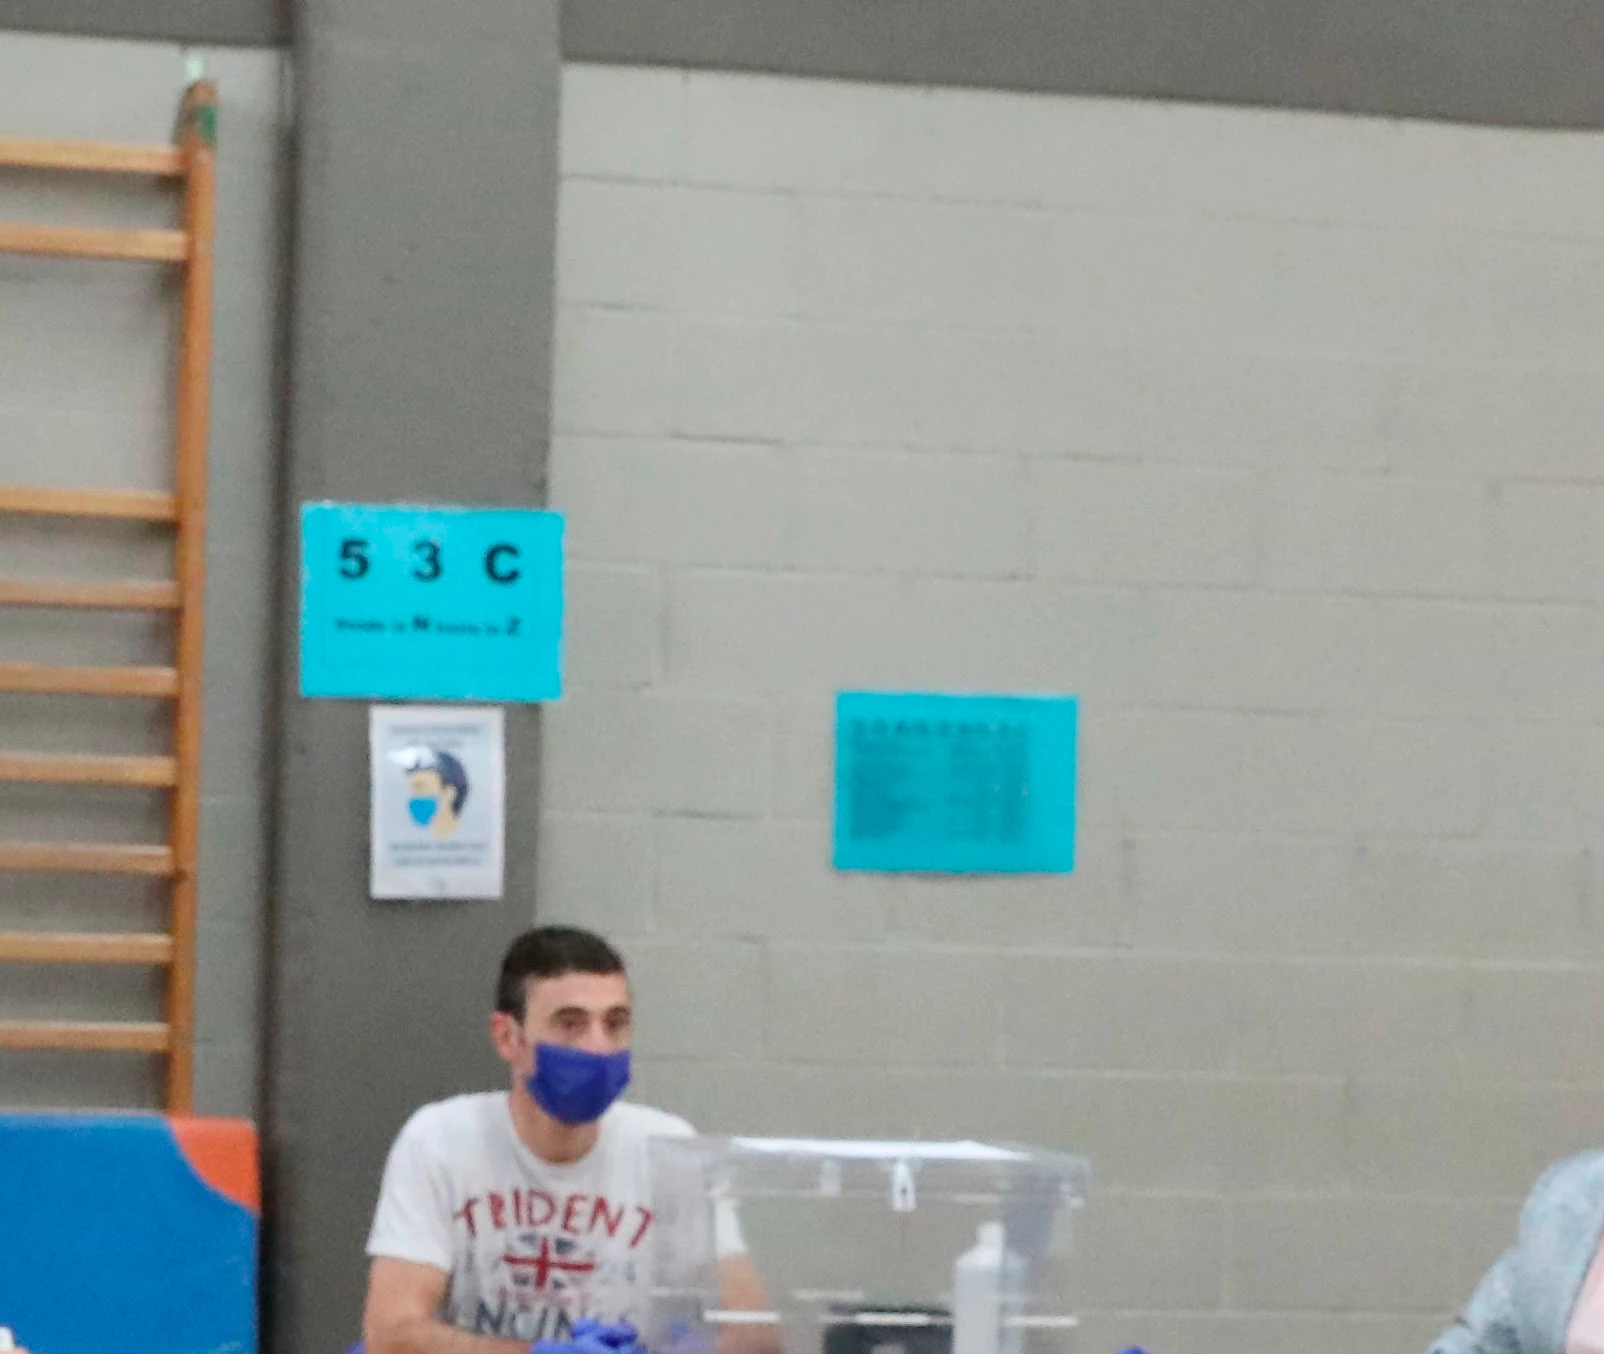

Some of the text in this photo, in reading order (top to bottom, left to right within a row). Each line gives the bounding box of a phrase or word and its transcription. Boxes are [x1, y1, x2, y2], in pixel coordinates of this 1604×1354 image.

[340, 540, 521, 584] 5 3 C
[453, 1188, 654, 1248] TRIDENT
